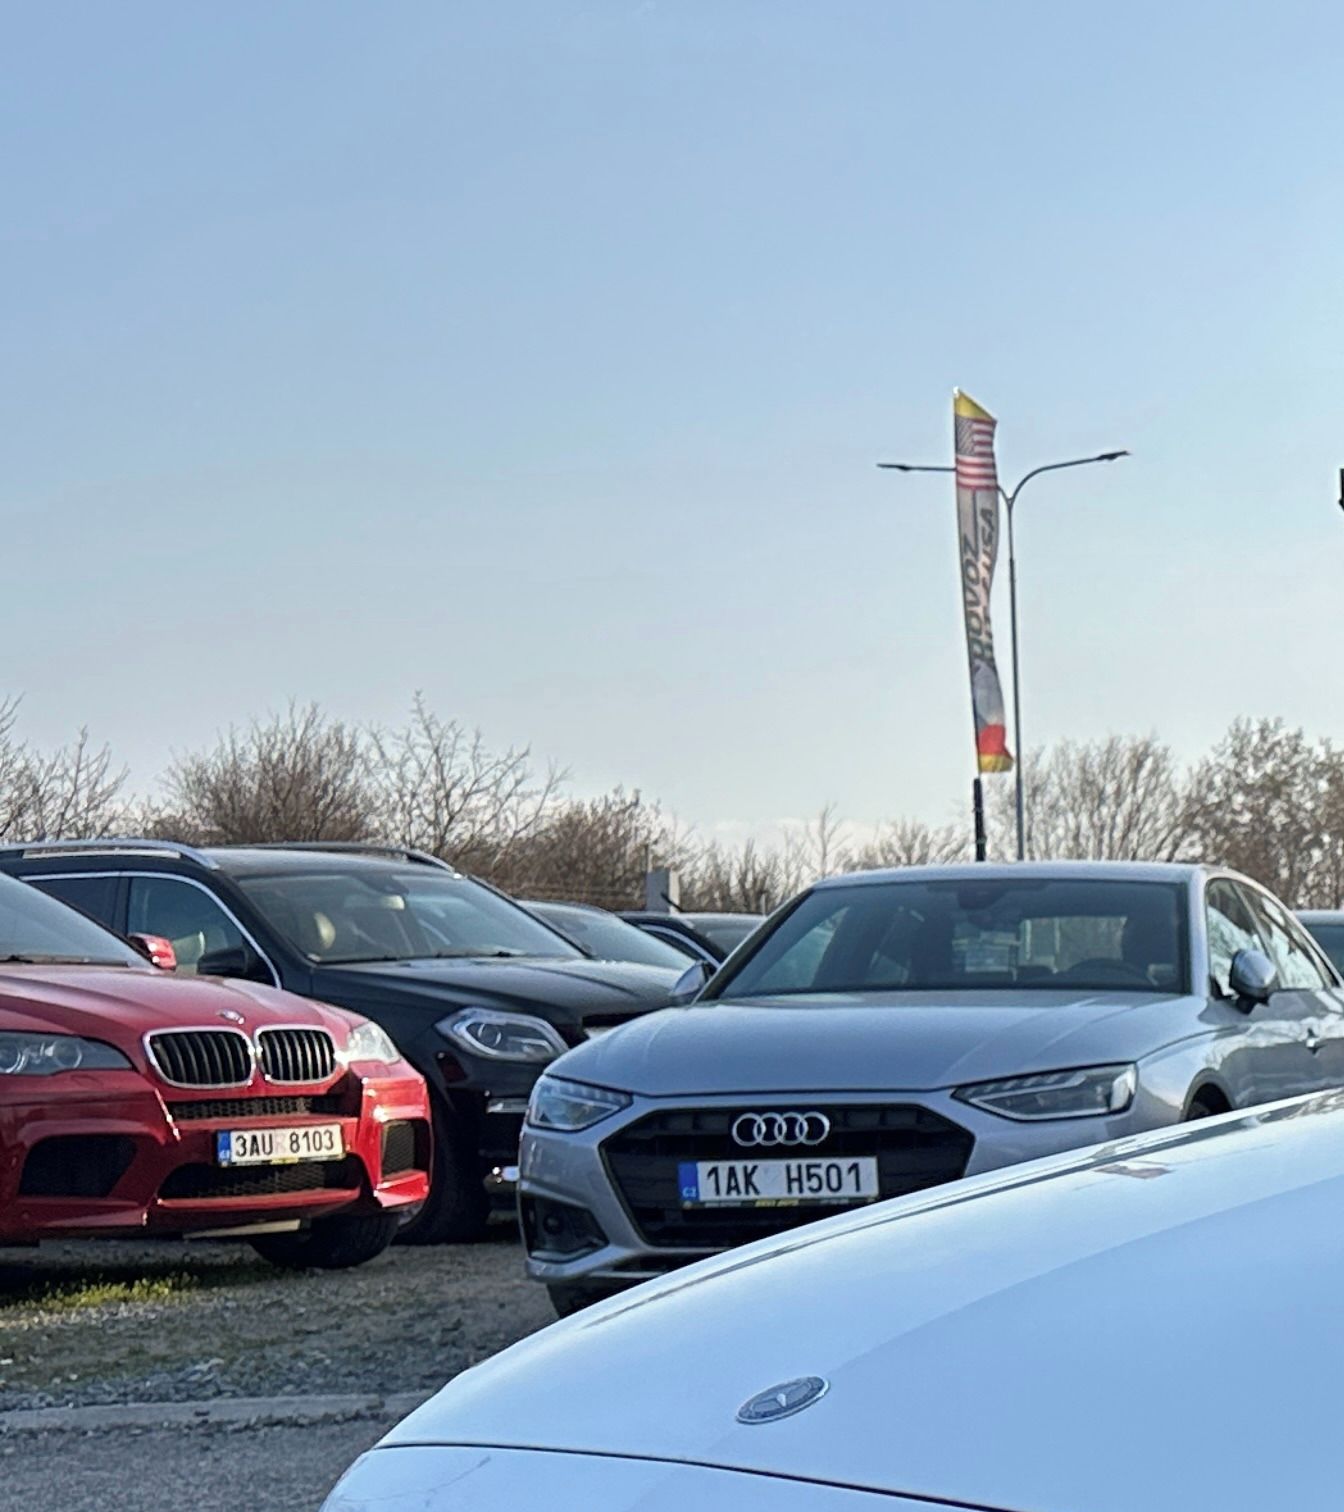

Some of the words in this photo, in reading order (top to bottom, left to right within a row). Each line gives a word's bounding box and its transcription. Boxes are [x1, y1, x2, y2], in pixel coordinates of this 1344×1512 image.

[235, 1133, 273, 1157] 3AU
[289, 1128, 334, 1154] 8103
[682, 1186, 697, 1198] CZ
[707, 1164, 760, 1197] 1AK
[786, 1161, 862, 1194] H501
